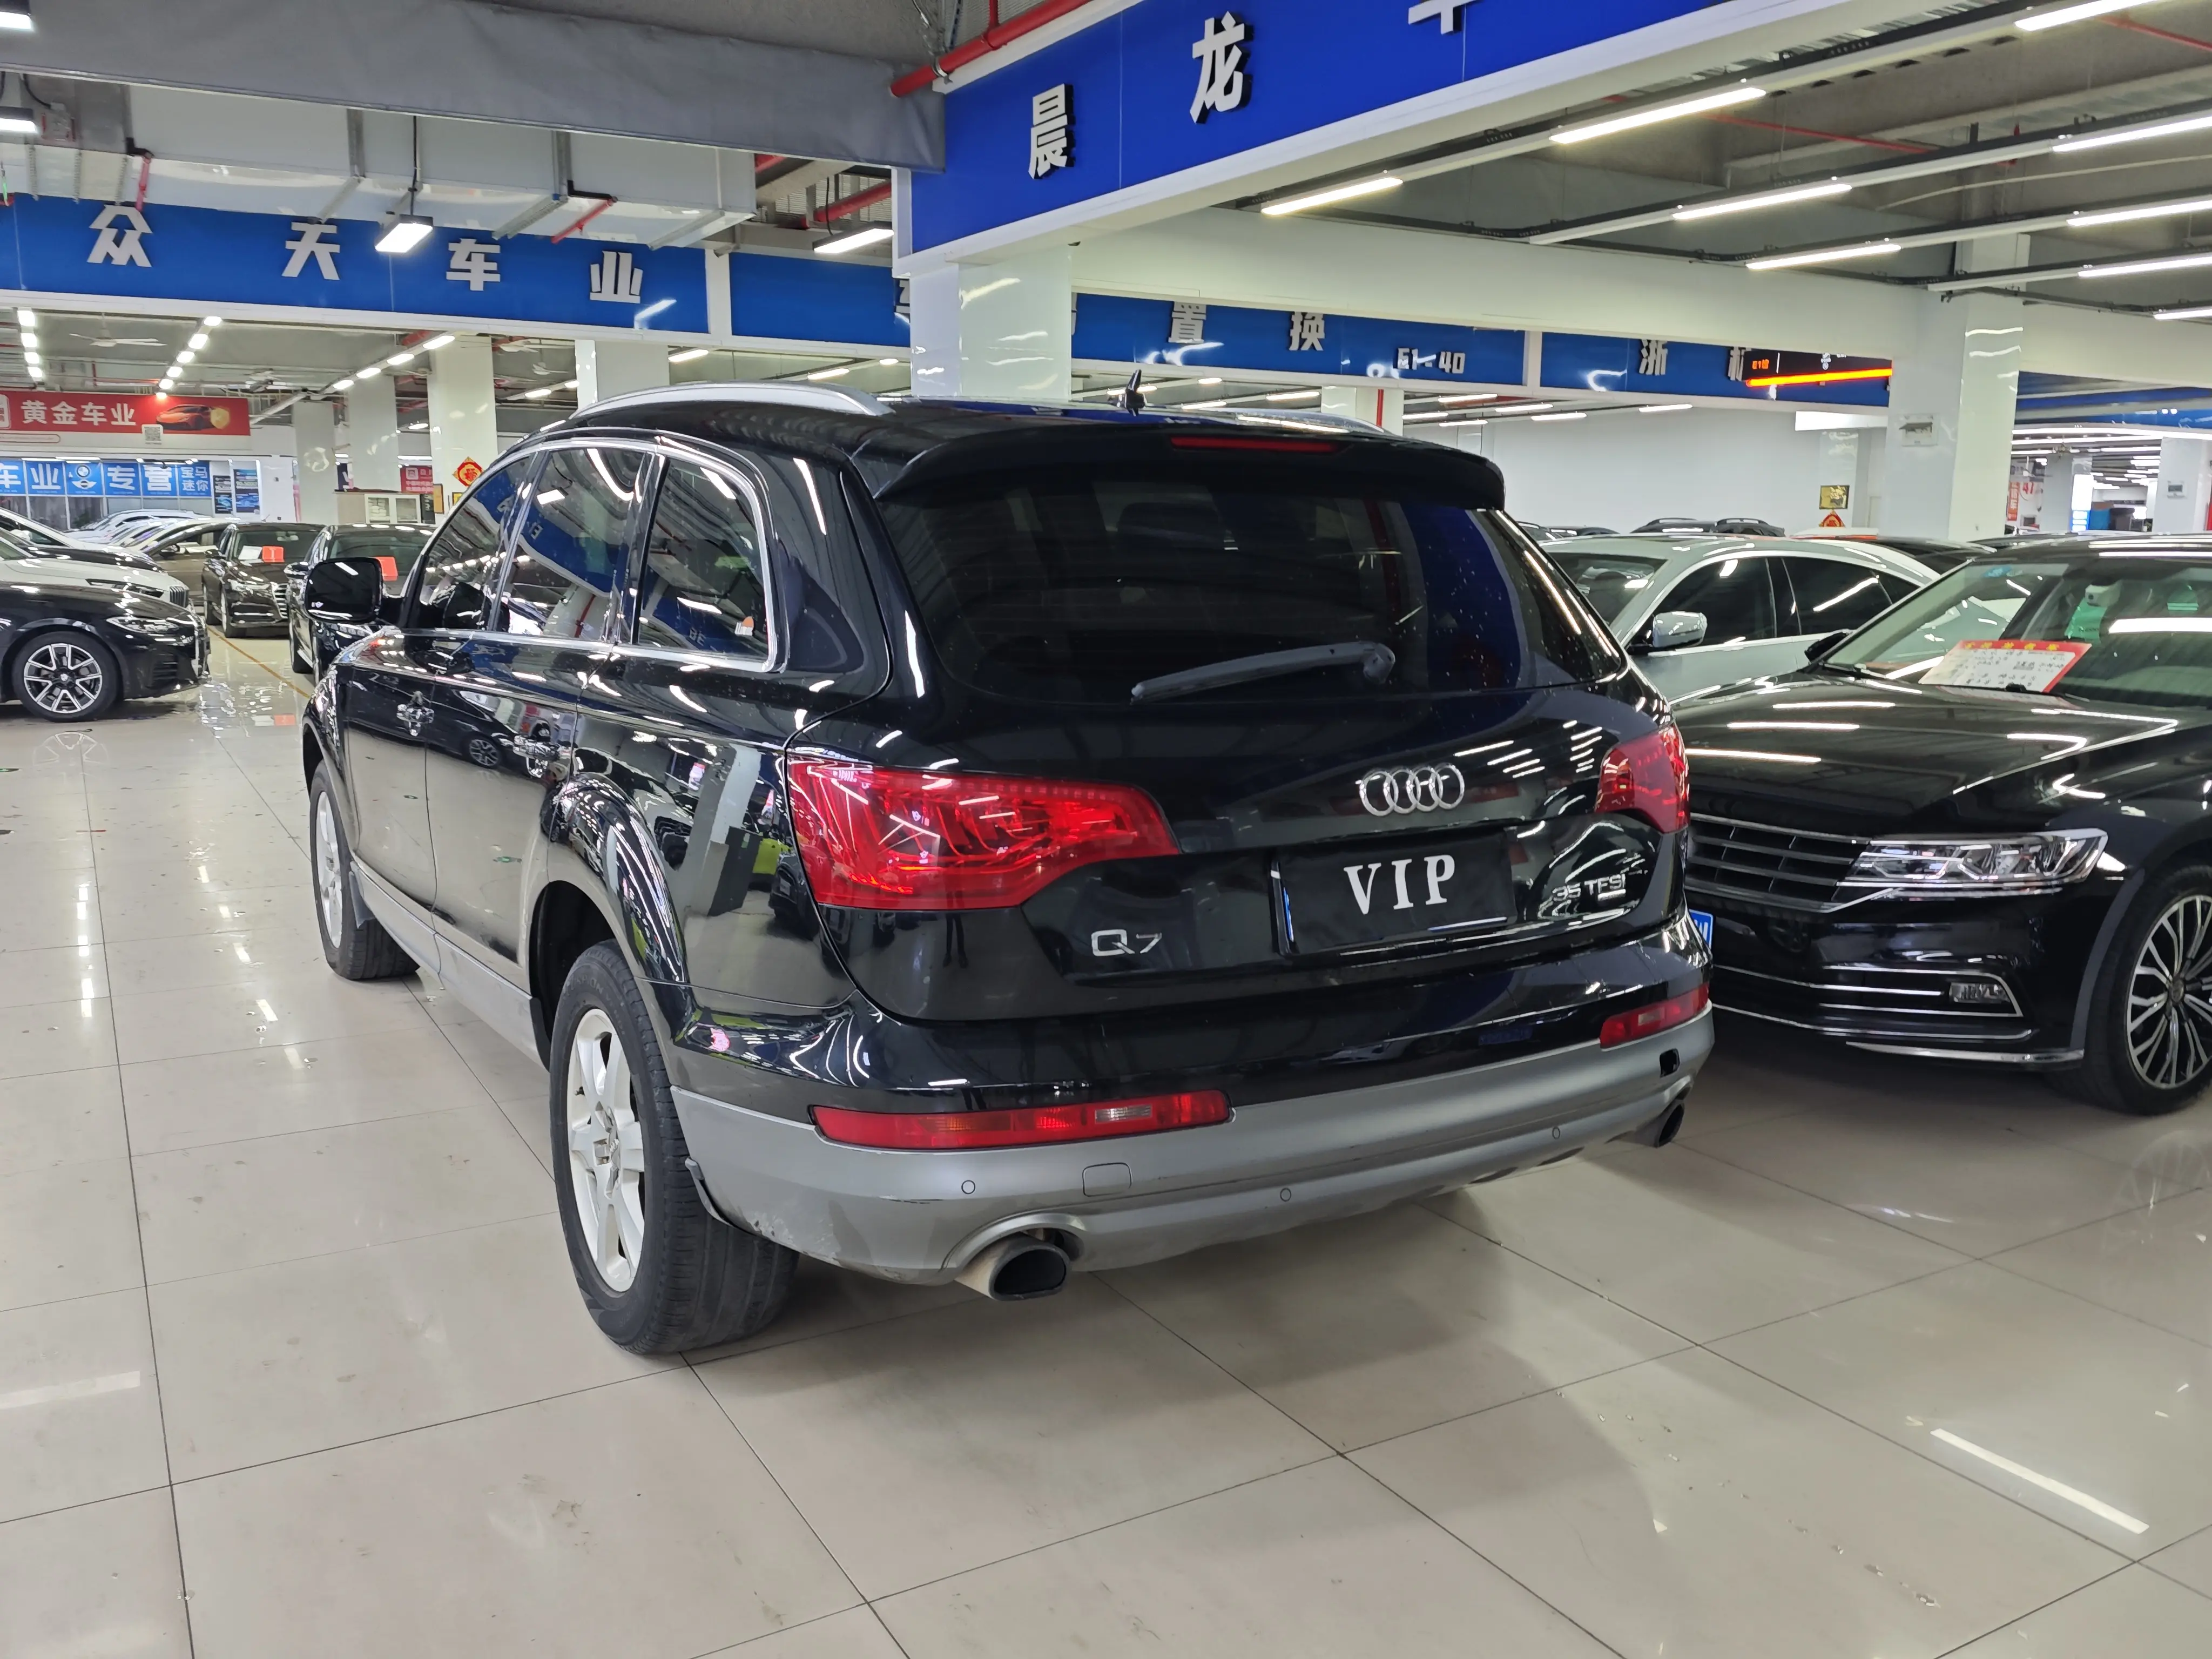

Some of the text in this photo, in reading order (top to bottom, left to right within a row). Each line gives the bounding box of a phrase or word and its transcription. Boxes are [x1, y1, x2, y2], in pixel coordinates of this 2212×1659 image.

[87, 204, 643, 304] 众天车业
[20, 400, 137, 426] 黄金车业
[107, 464, 172, 491] 专营
[1343, 853, 1456, 916] VIP
[1552, 873, 1626, 902] 35 TFSI
[1089, 928, 1164, 957] Q7
